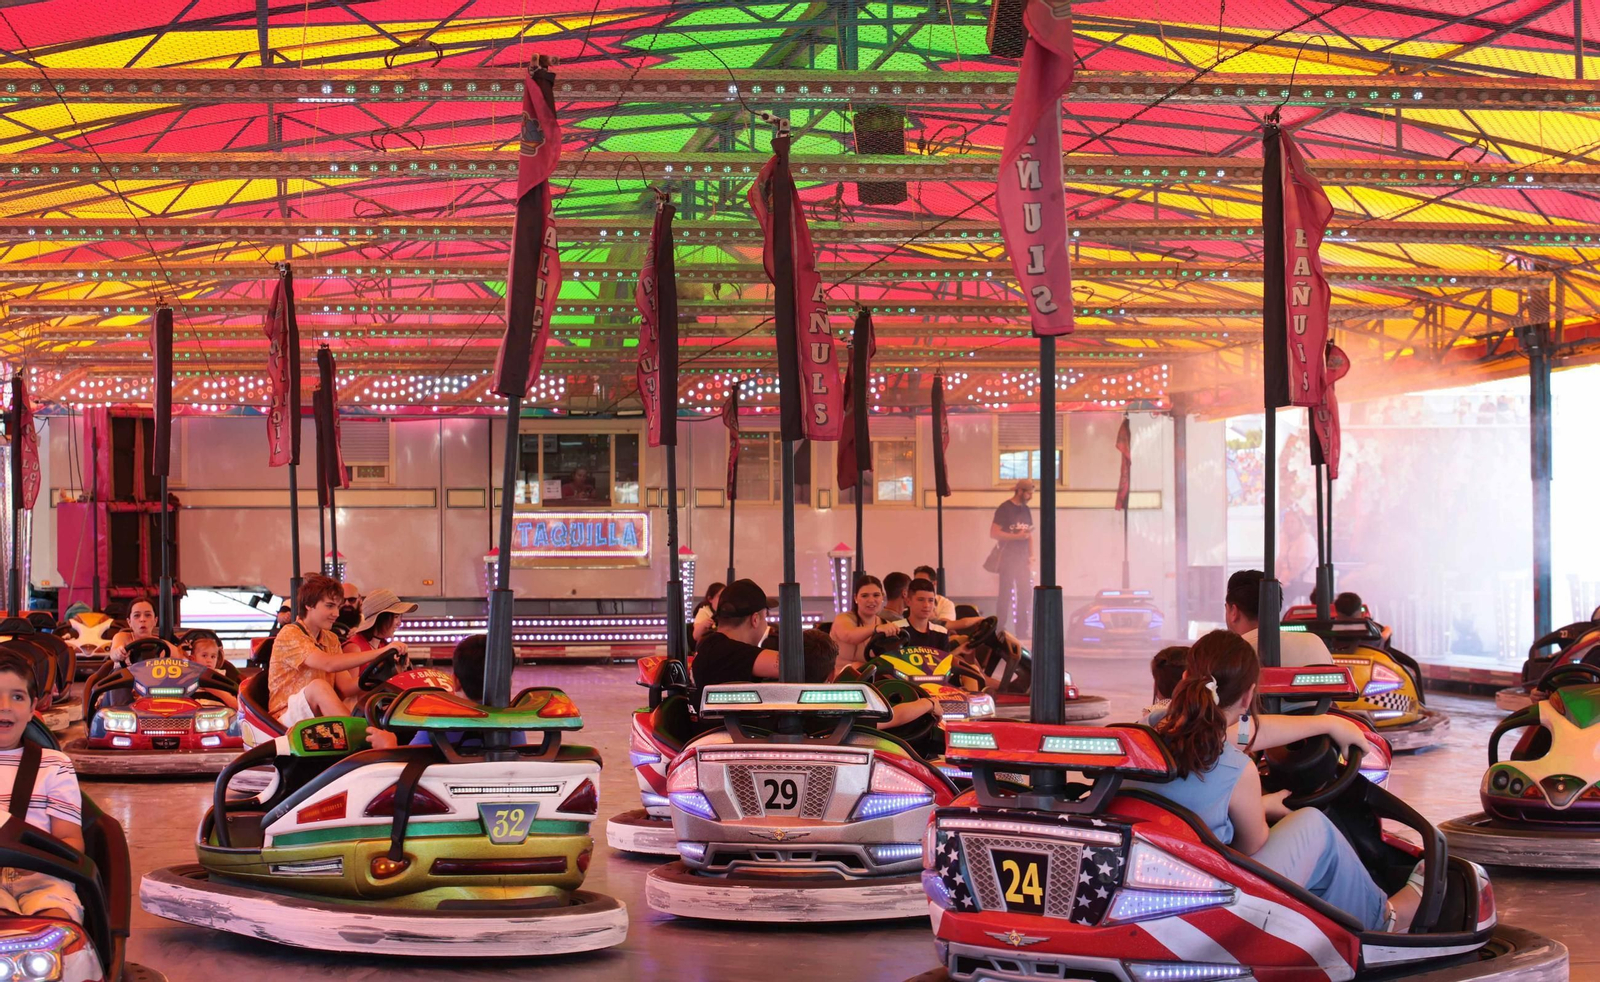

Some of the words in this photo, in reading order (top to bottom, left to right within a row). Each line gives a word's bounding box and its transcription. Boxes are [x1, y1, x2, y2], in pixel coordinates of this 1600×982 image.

[517, 522, 637, 547] TAQUILLA
[146, 658, 189, 667] F.BAÑULS
[909, 653, 937, 666] 01
[152, 665, 182, 679] 09
[423, 677, 453, 692] 15
[764, 779, 798, 810] 29
[492, 808, 525, 838] 32
[1002, 859, 1044, 906] 24
